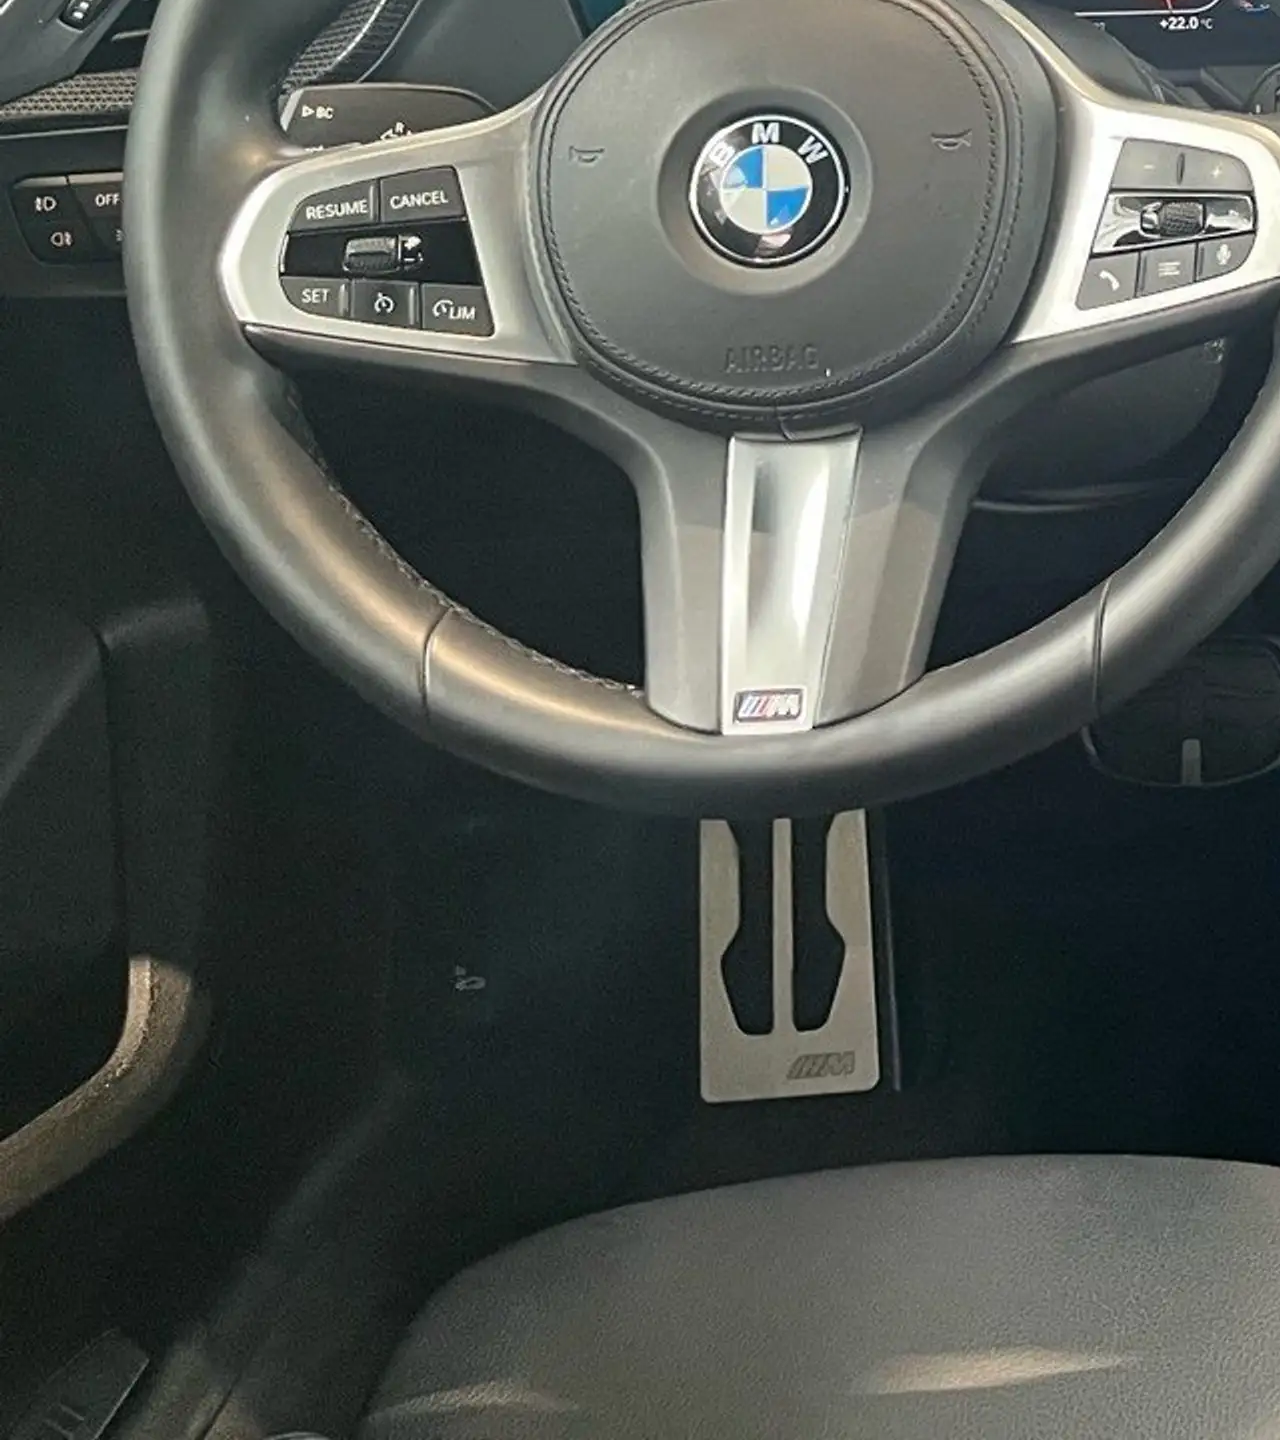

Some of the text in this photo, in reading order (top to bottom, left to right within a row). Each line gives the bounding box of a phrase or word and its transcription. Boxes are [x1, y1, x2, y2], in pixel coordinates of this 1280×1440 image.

[1159, 16, 1200, 30] +22.0
[315, 106, 335, 120] BC
[708, 122, 829, 167] BMW
[95, 192, 121, 207] OFF
[389, 190, 450, 210] CANCEL
[304, 198, 369, 221] RESUME
[301, 288, 331, 304] SET
[449, 304, 477, 321] LIM
[723, 344, 821, 374] AIRBAG
